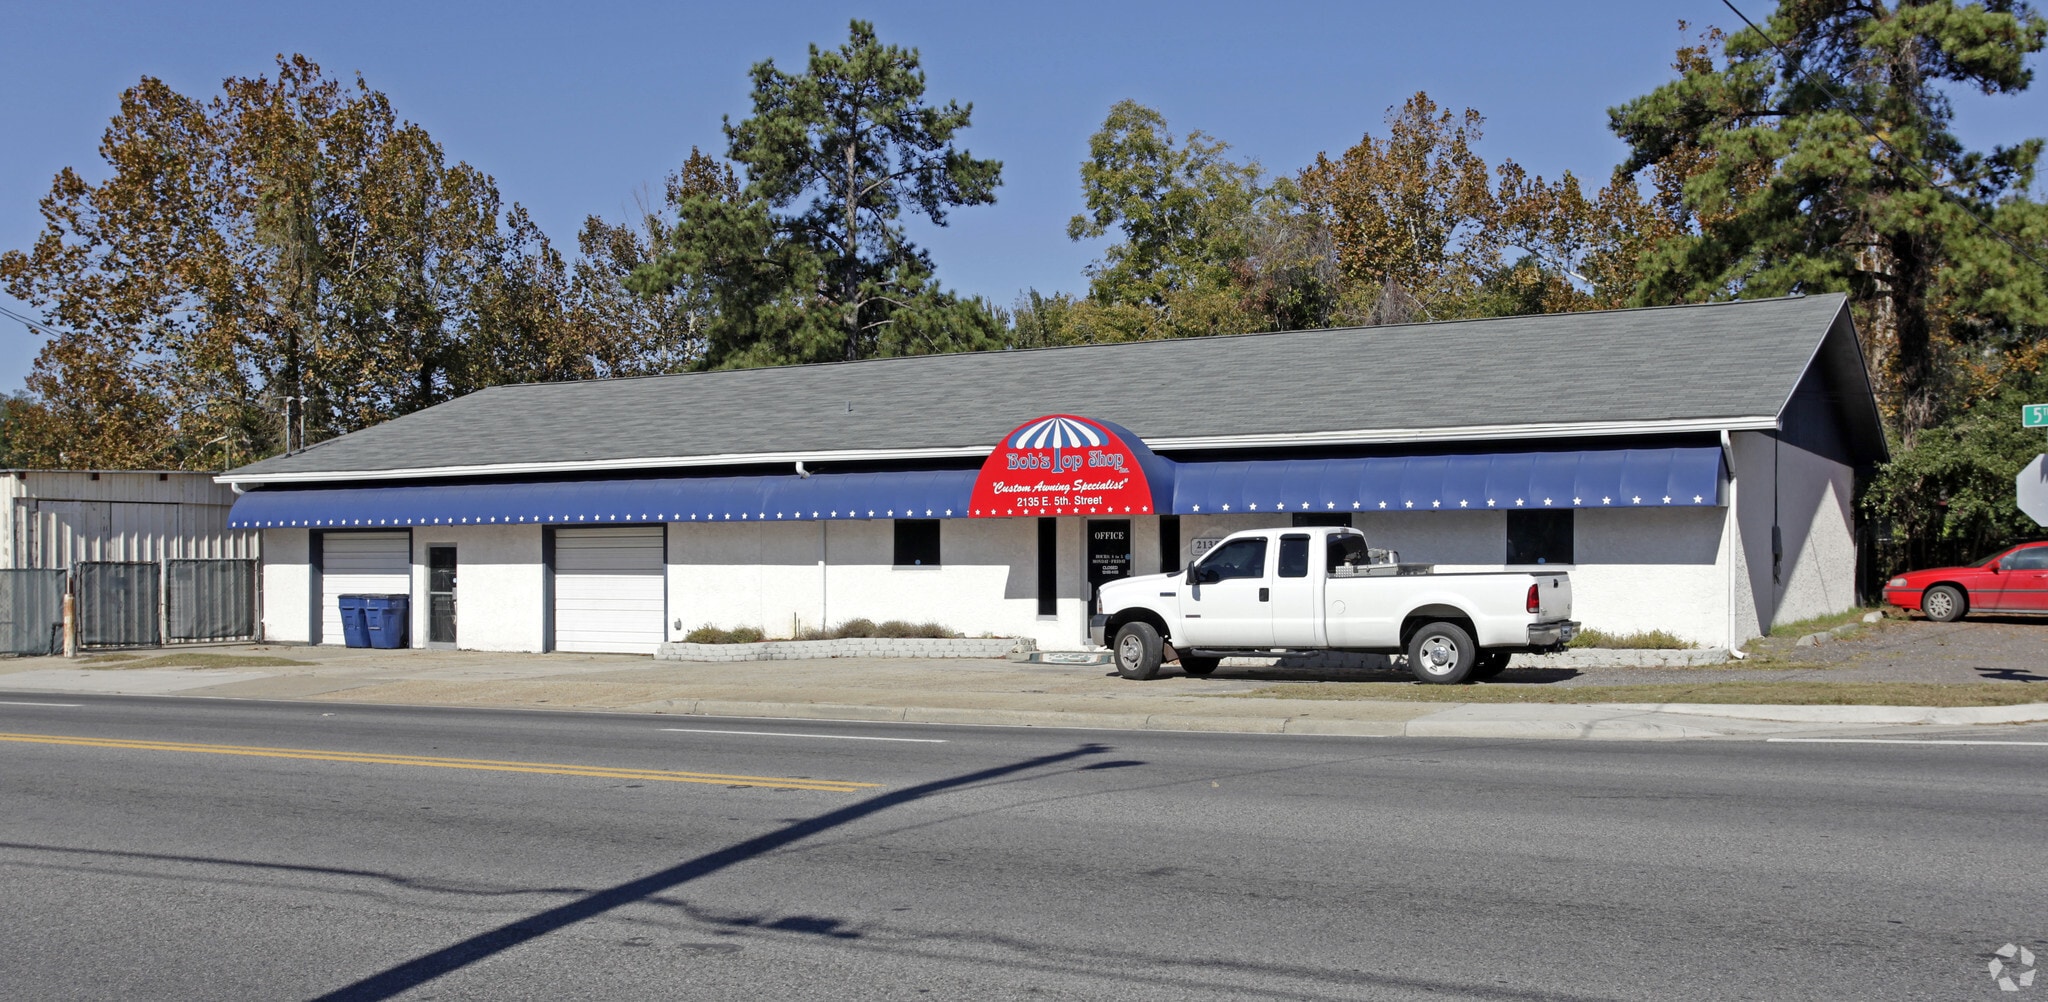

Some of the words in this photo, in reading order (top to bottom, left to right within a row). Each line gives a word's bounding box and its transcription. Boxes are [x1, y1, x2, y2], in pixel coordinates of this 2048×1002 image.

[2033, 407, 2048, 423] 5T
[1006, 452, 1051, 470] Bob's
[1051, 448, 1083, 473] Top
[1088, 450, 1124, 470] Shop
[992, 481, 1032, 494] "Custom
[1031, 480, 1070, 494] Awning
[1072, 478, 1129, 493] Specialist"
[1017, 497, 1039, 507] 2135
[1042, 496, 1051, 506] E.
[1054, 496, 1072, 506] 5th.
[1074, 495, 1103, 505] Street
[1094, 531, 1124, 540] OFFICE
